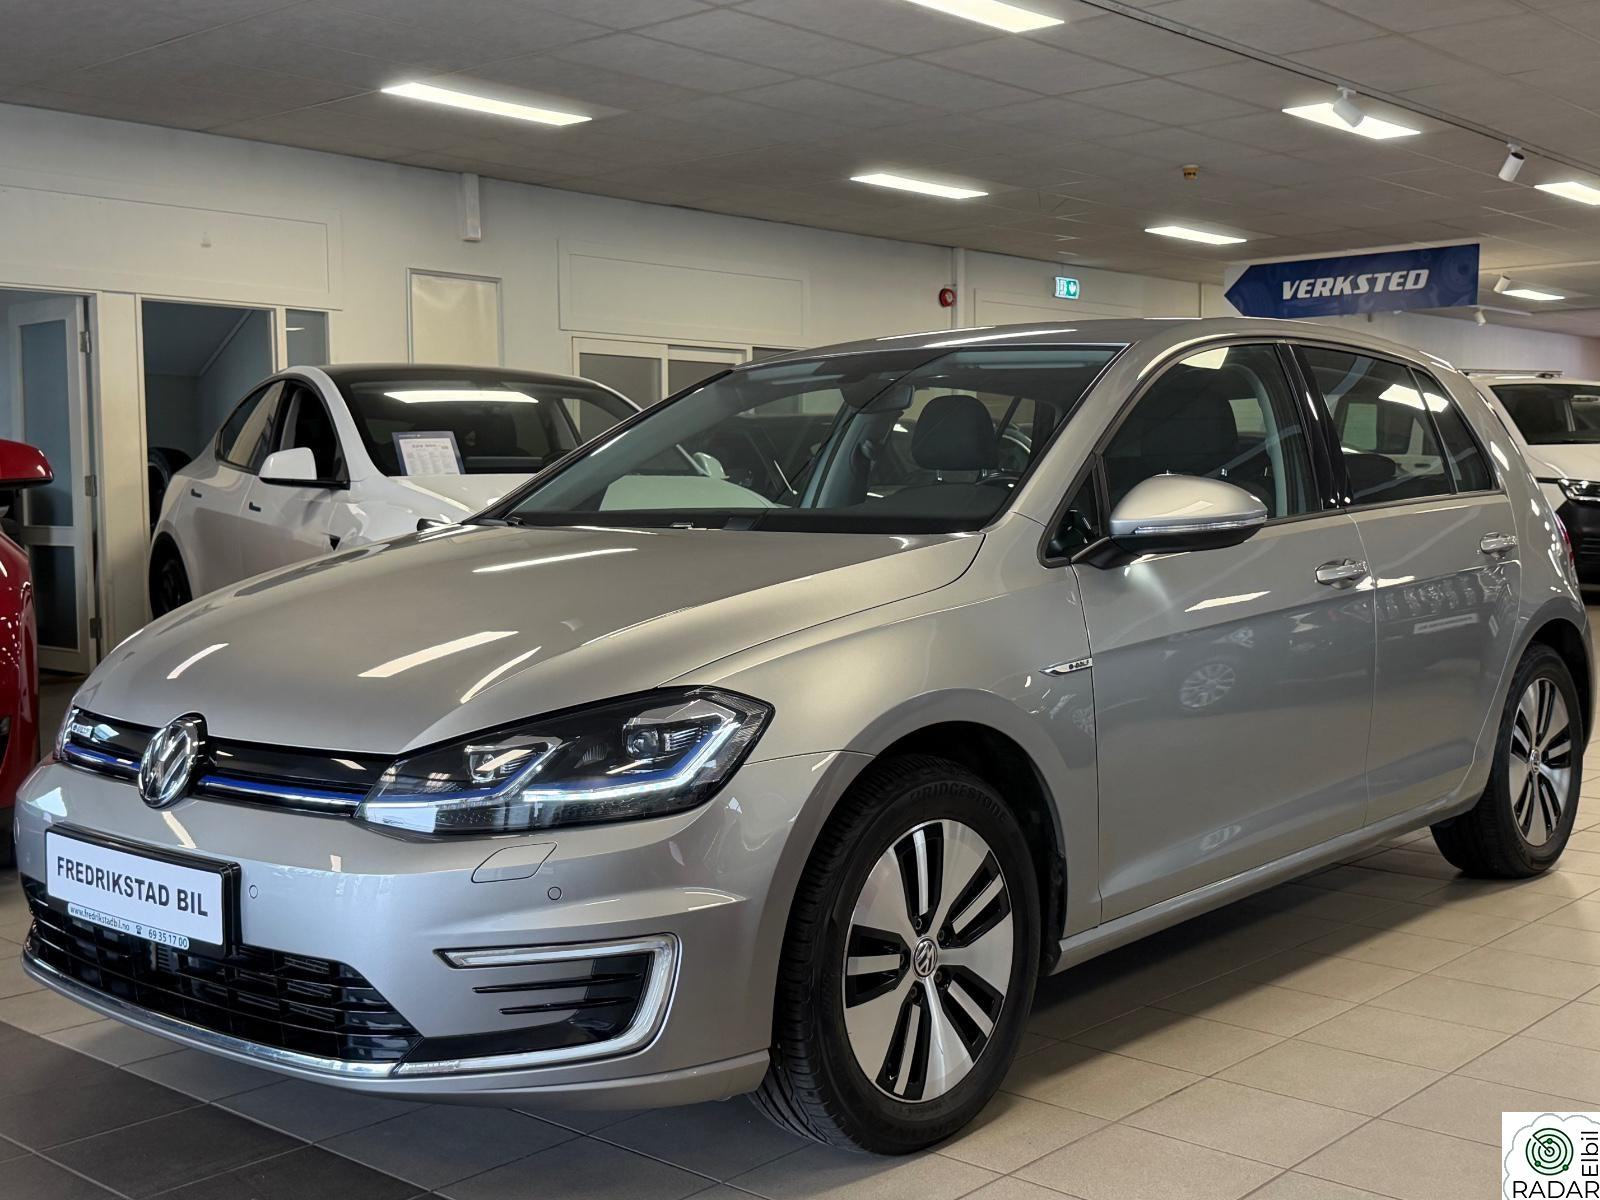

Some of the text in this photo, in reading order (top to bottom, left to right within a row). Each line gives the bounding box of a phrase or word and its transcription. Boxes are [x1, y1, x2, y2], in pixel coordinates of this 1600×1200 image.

[1282, 269, 1430, 300] VERKSTED
[57, 855, 208, 917] FREDRIKSTAD BIL
[148, 928, 157, 940] 69
[158, 931, 167, 942] 35
[168, 933, 176, 945] 17
[178, 936, 188, 948] 00
